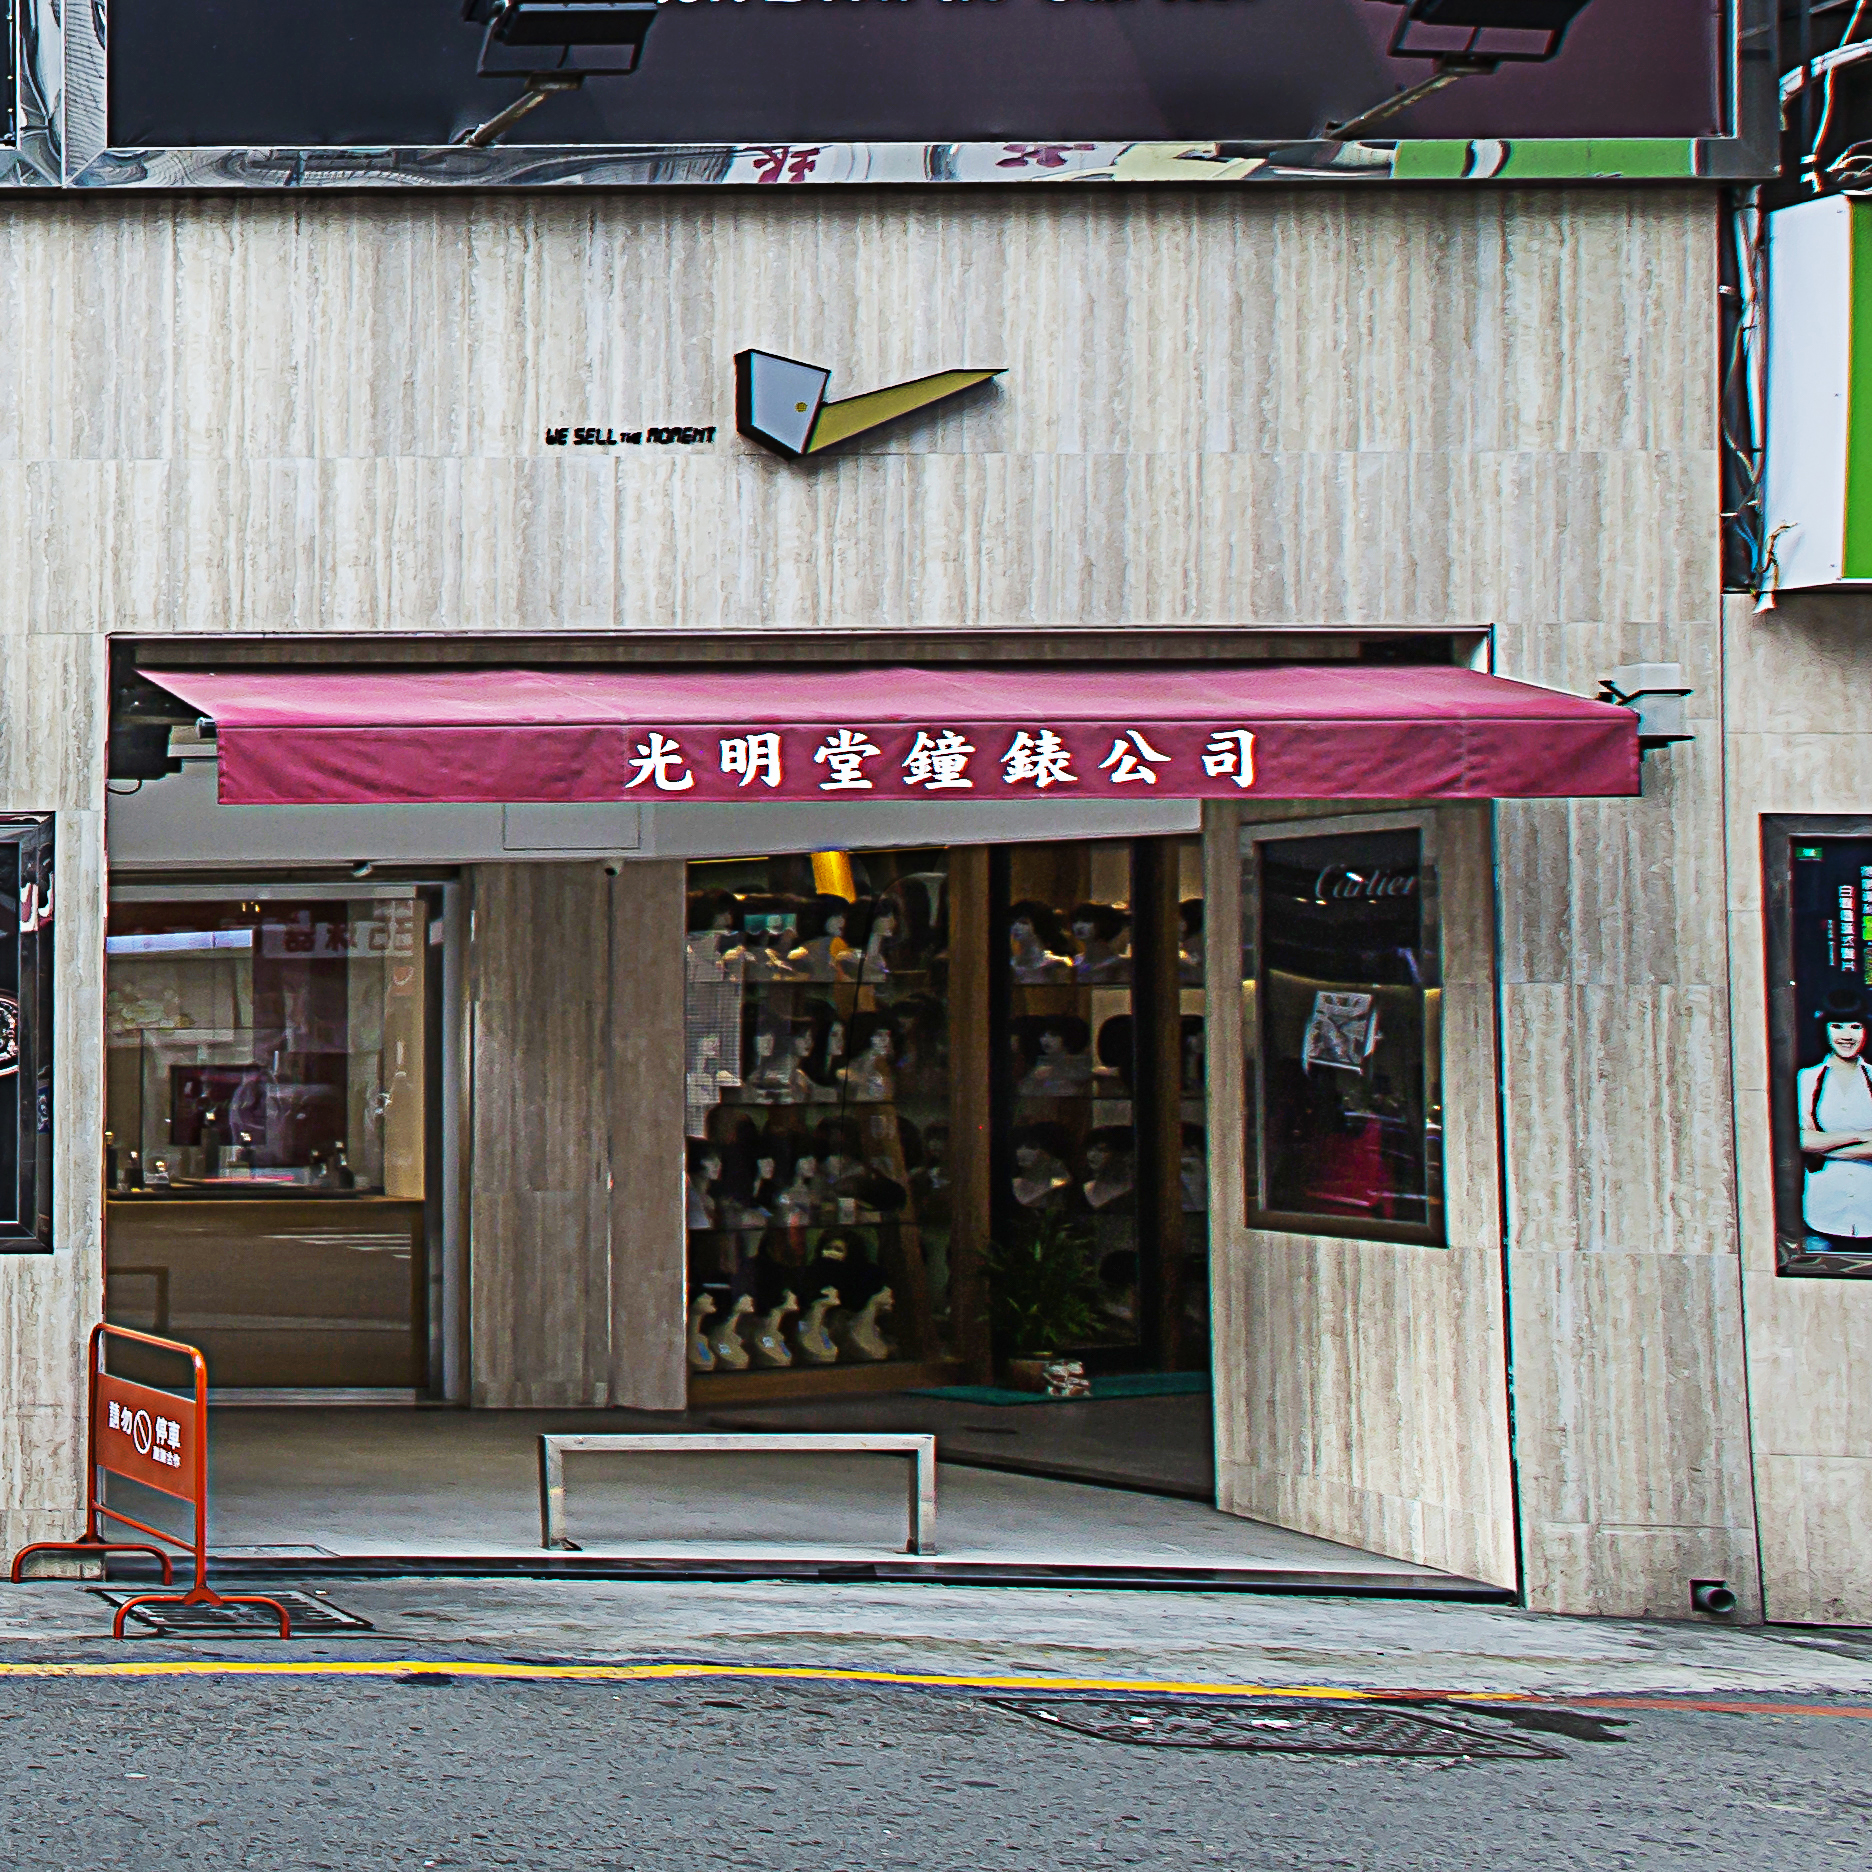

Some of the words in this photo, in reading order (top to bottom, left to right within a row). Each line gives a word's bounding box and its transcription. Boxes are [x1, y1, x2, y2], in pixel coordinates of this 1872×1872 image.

[572, 427, 618, 446] SELL
[645, 426, 717, 446] MOMENT
[624, 727, 1257, 791] 光明堂鐘錶公司
[1315, 863, 1420, 900] Cartier
